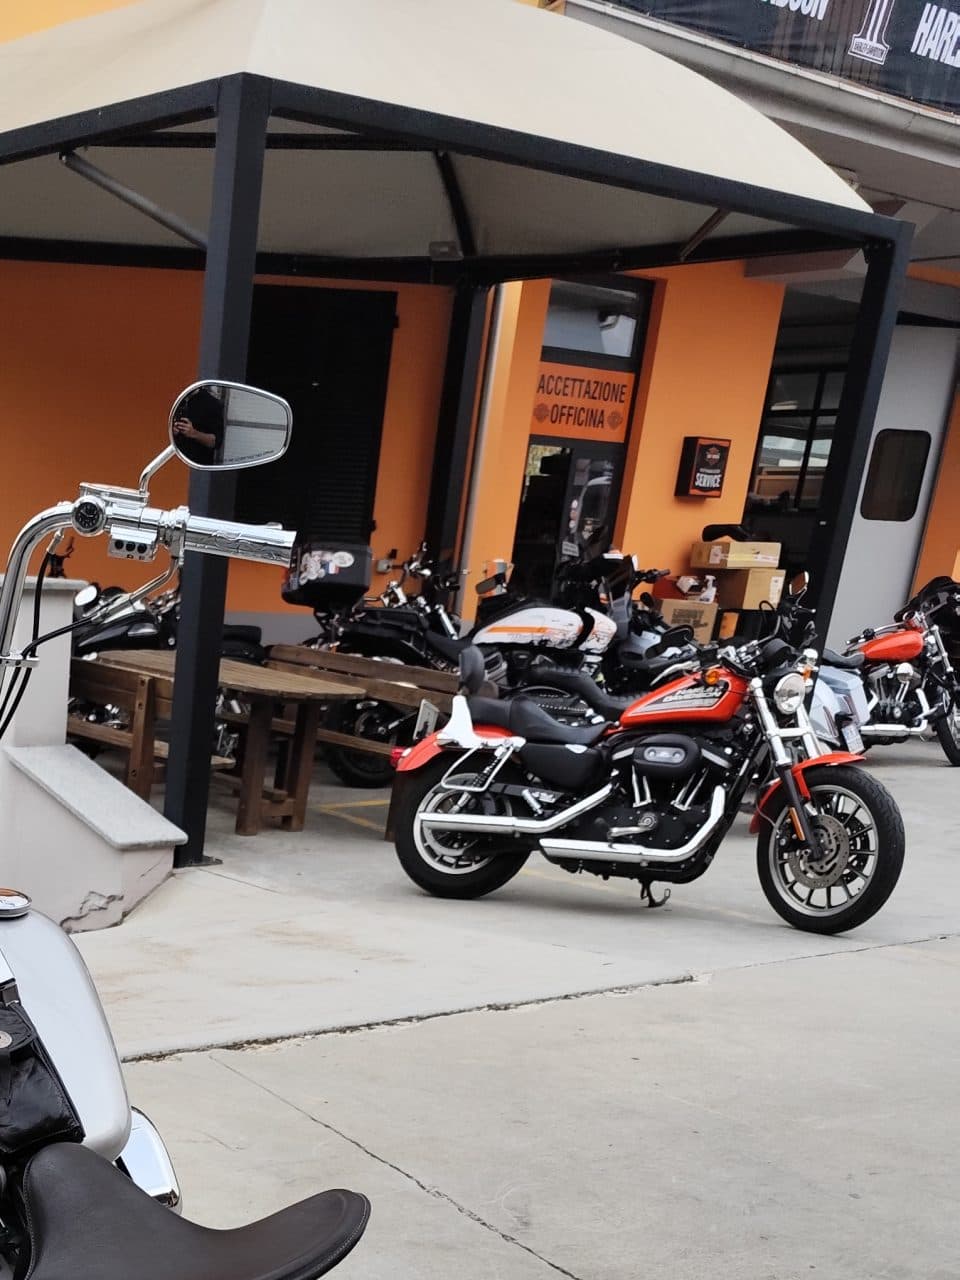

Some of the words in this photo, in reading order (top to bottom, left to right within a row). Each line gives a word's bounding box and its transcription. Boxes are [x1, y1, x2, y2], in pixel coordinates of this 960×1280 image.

[910, 2, 960, 68] HARL
[536, 374, 628, 404] ACCETTAZIONE
[550, 404, 605, 428] OFFICINA
